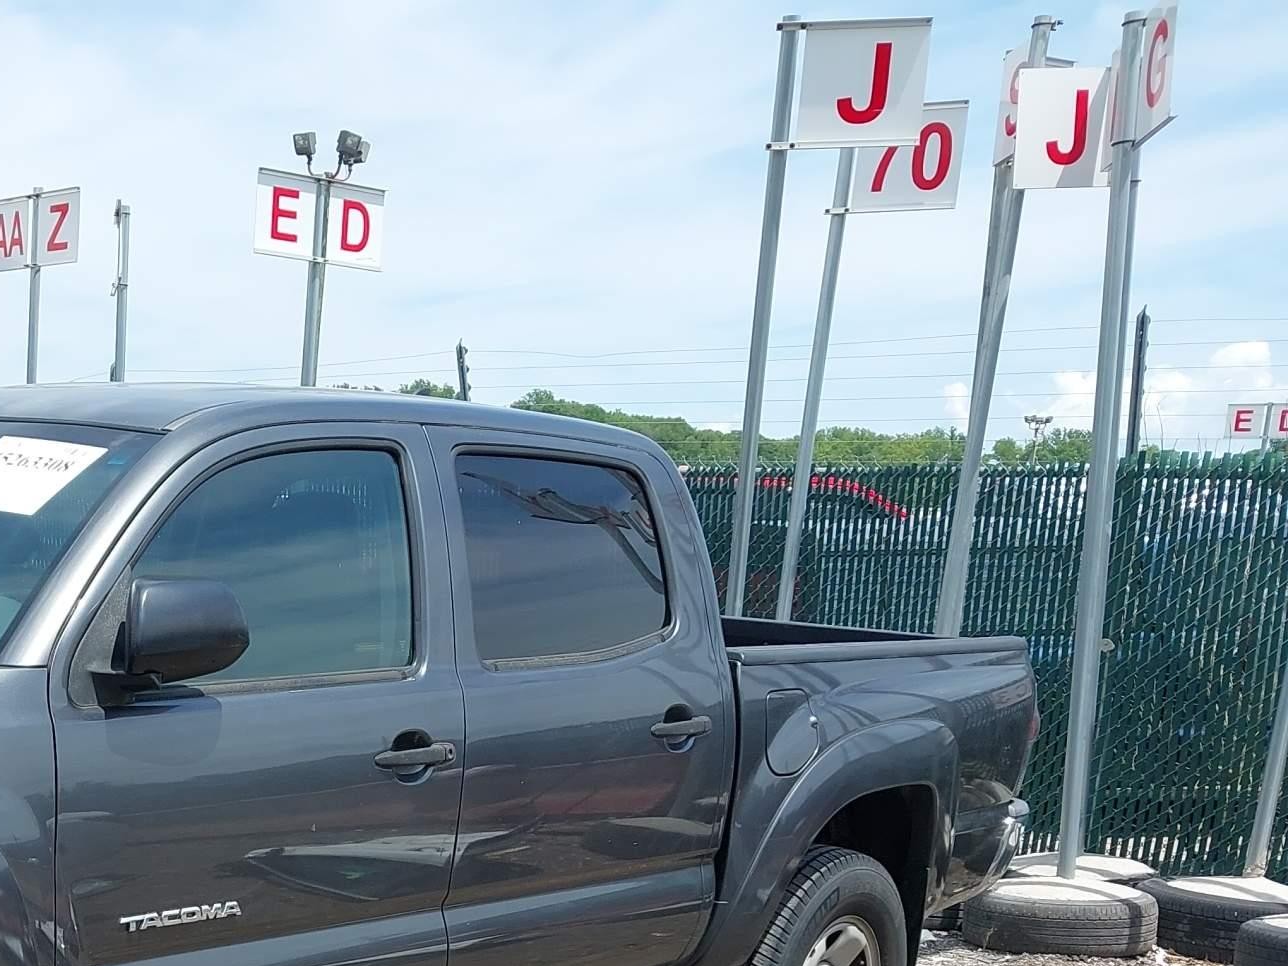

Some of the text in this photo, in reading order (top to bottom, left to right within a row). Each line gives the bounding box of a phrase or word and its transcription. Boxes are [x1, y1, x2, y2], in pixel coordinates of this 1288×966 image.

[836, 41, 893, 125] J
[1146, 18, 1170, 109] G
[1046, 89, 1090, 166] J
[46, 202, 70, 252] Z
[269, 185, 301, 244] E
[339, 198, 371, 254] D
[1233, 409, 1254, 432] E
[119, 900, 242, 933] TACOMA
